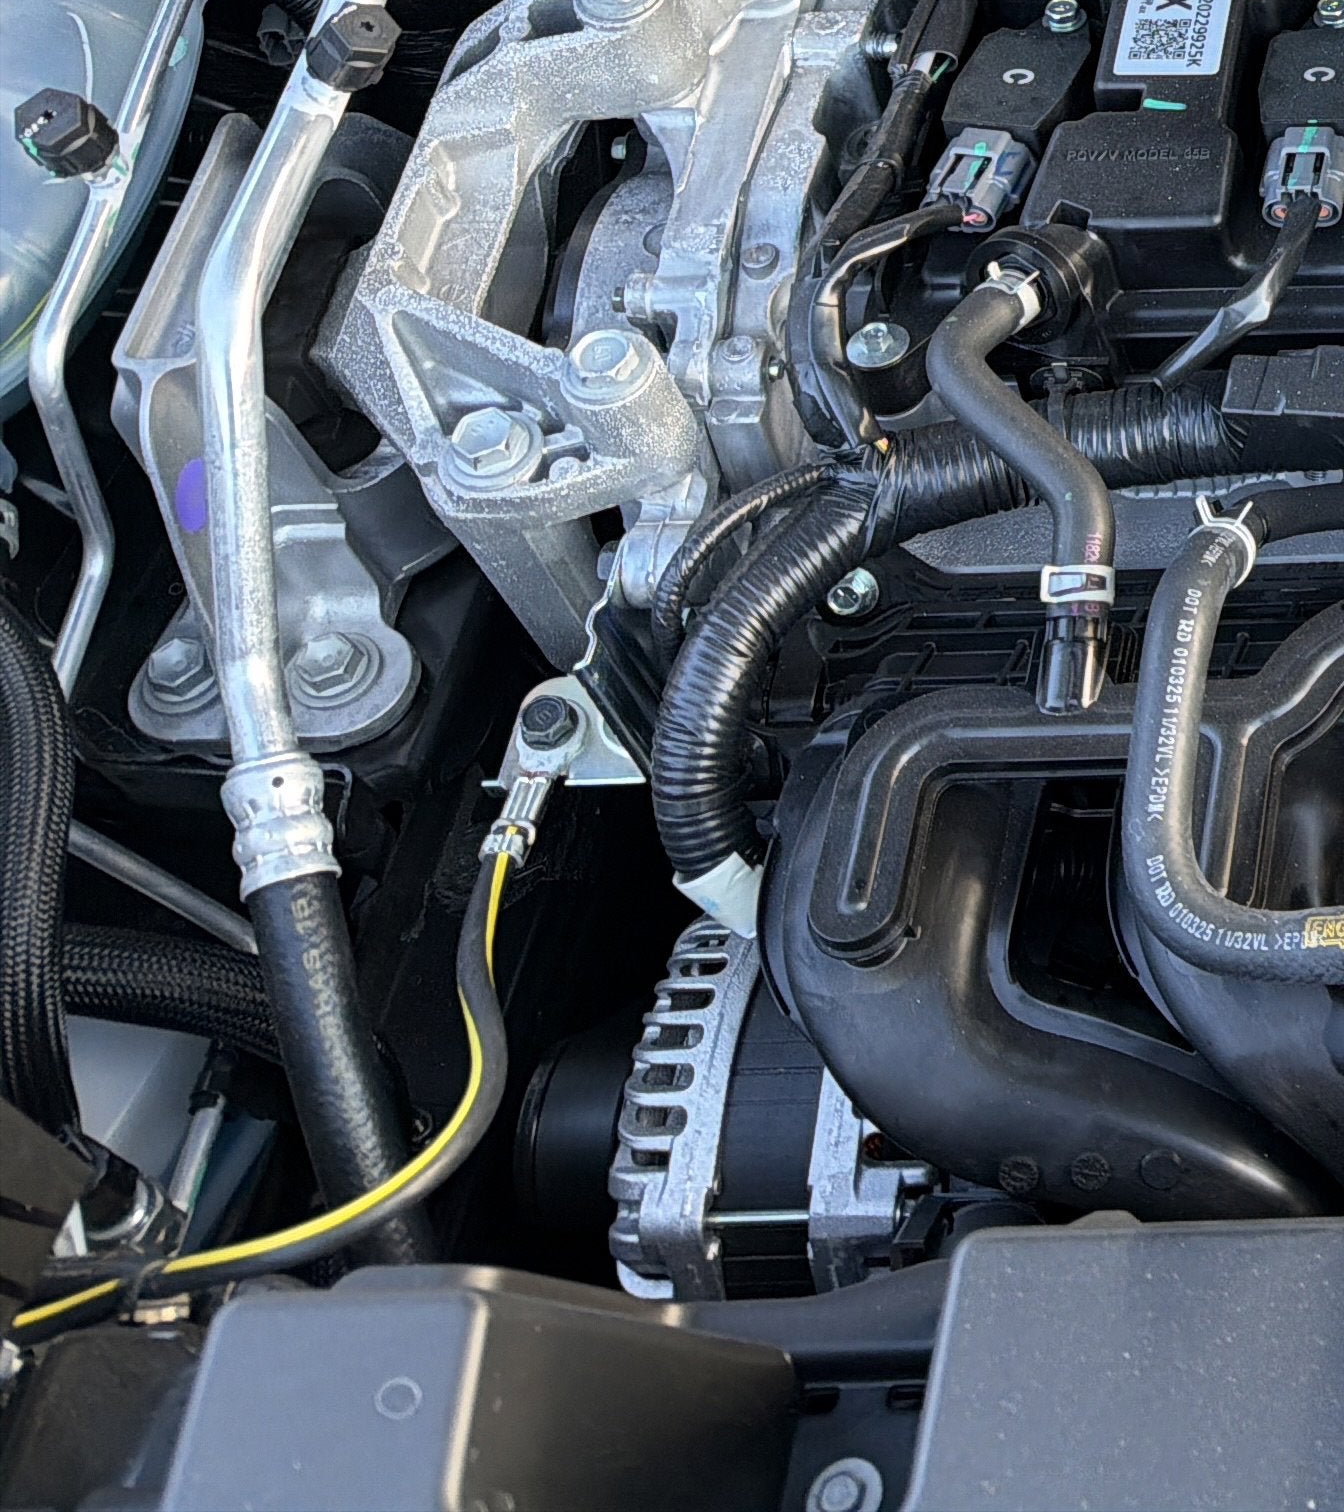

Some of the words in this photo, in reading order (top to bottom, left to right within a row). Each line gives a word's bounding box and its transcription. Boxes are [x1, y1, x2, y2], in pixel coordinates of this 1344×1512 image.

[1003, 68, 1035, 85] C
[1303, 66, 1336, 83] C
[1123, 148, 1178, 161] MODEL
[1166, 648, 1188, 703] 010325
[1146, 854, 1168, 882] DOT
[1168, 902, 1216, 941] 010325
